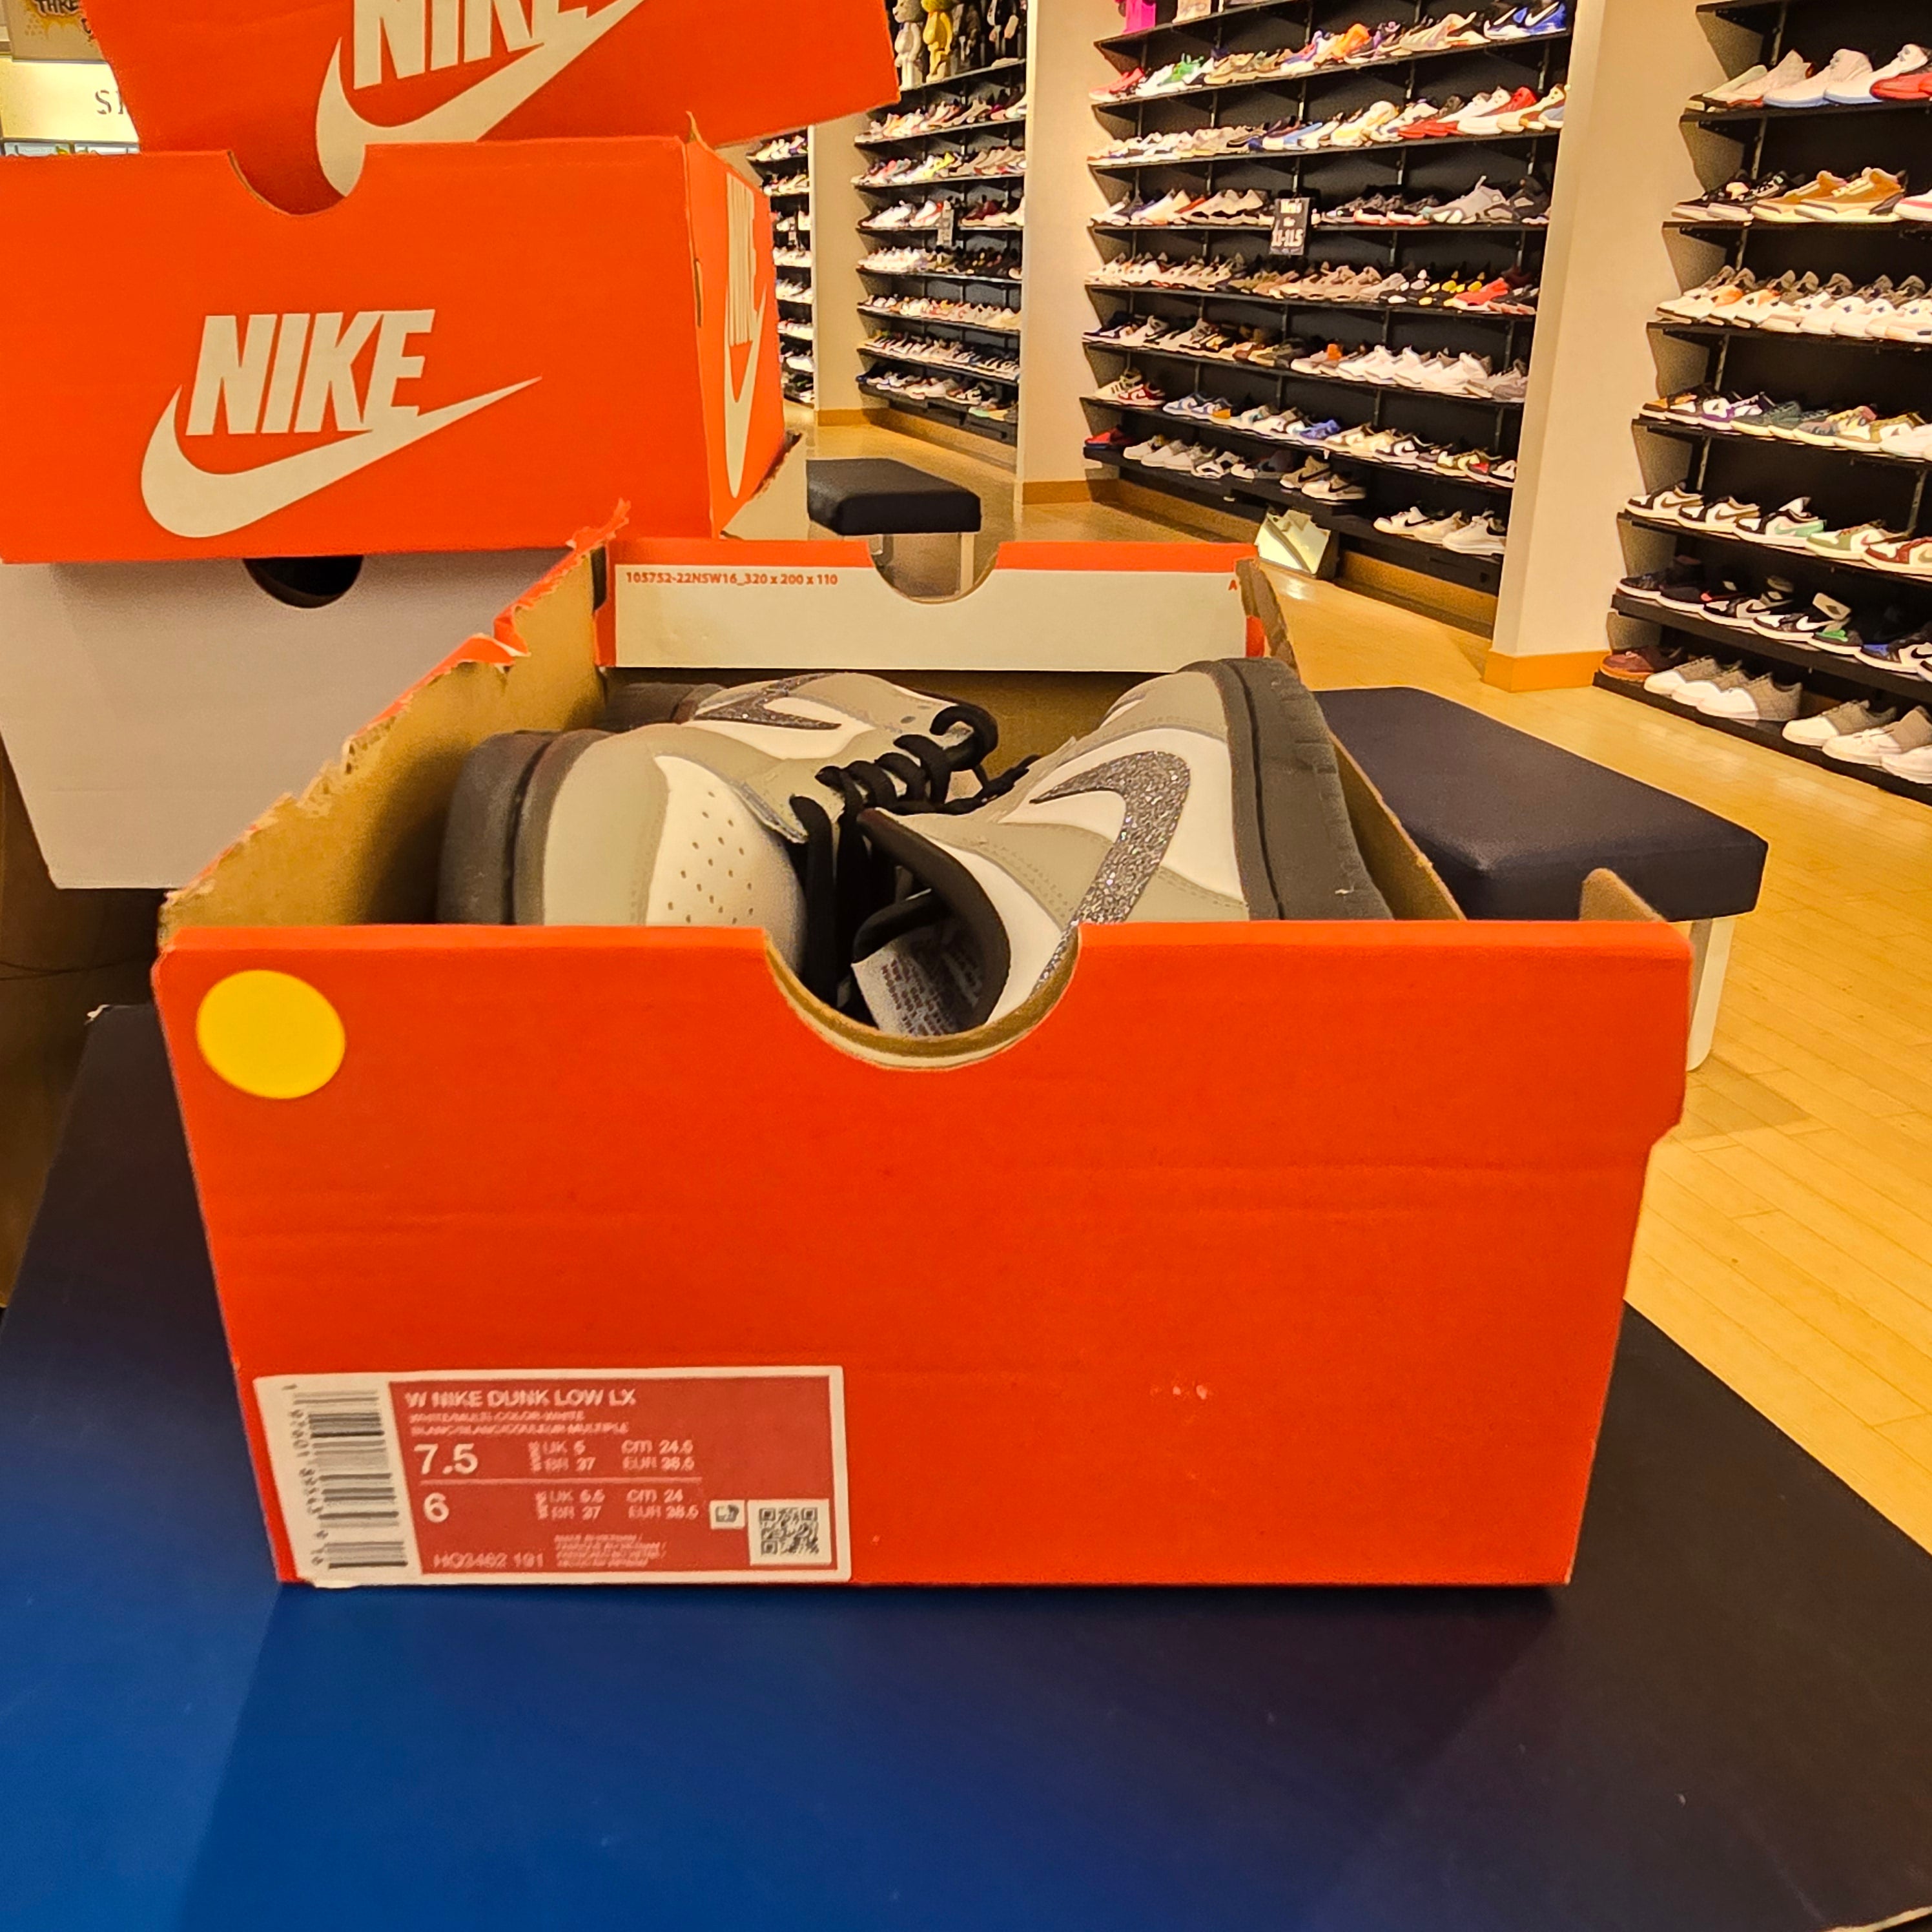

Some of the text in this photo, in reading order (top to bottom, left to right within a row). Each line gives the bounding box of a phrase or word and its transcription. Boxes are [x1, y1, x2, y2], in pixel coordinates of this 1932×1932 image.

[185, 309, 436, 436] NIKE
[780, 574, 804, 585] 200
[817, 574, 838, 585] 110
[431, 1391, 482, 1408] NIKE
[486, 1390, 550, 1407] DUNK
[553, 1389, 603, 1407] LOW
[608, 1389, 636, 1406] LX
[413, 1443, 478, 1475] 7.5
[424, 1492, 449, 1523] 6
